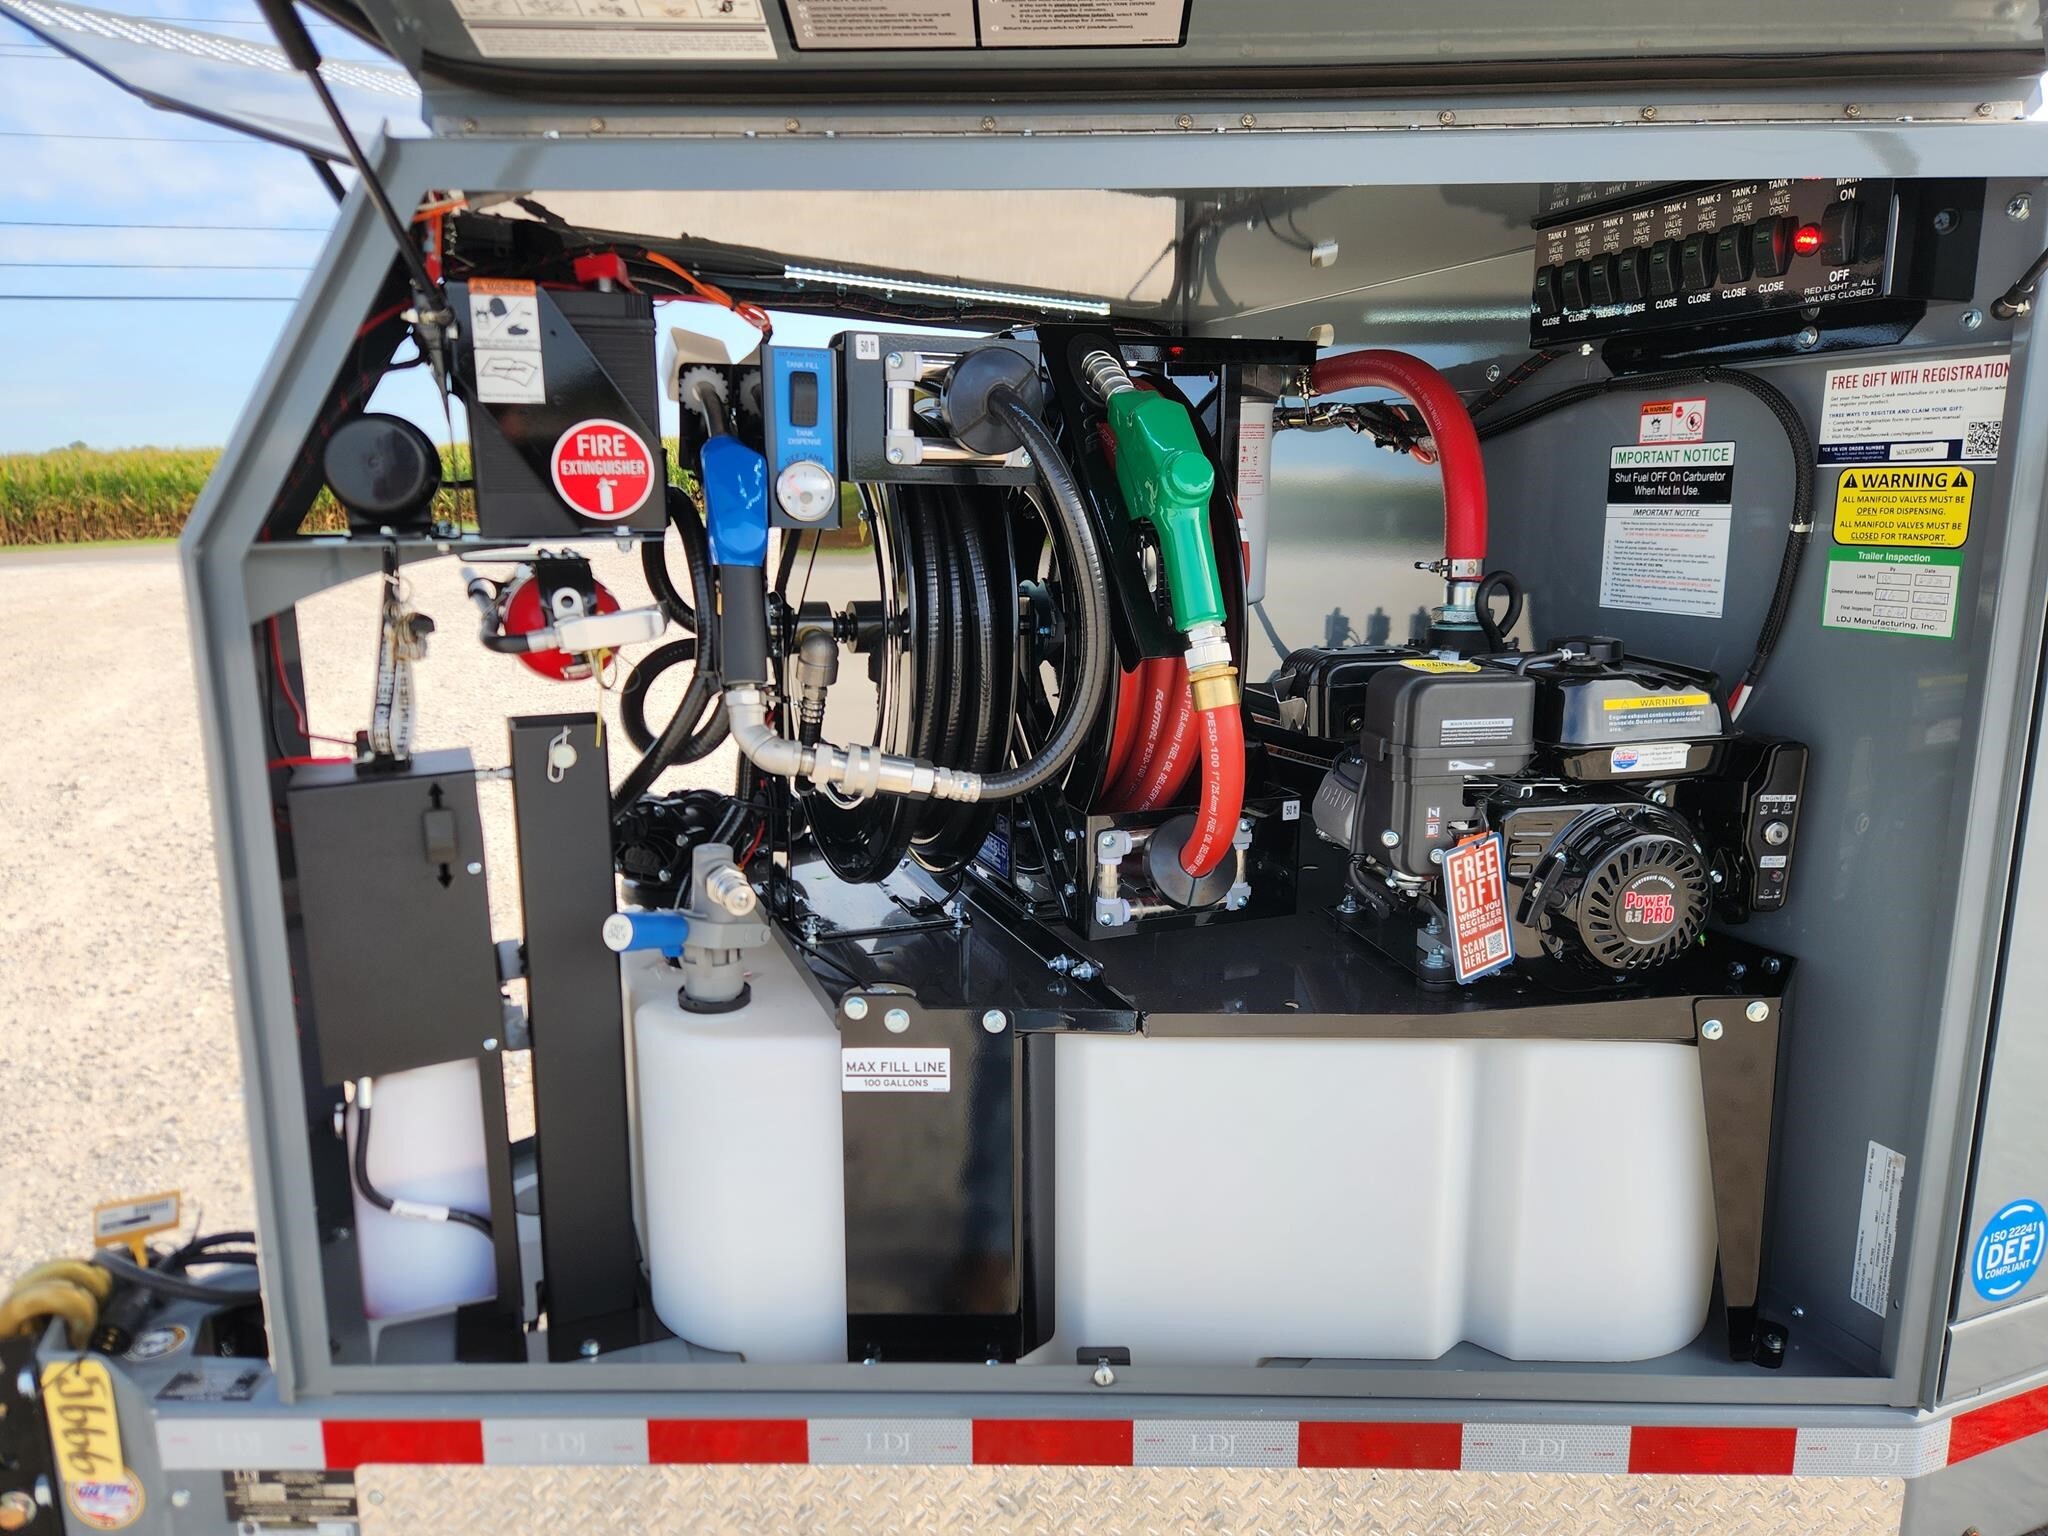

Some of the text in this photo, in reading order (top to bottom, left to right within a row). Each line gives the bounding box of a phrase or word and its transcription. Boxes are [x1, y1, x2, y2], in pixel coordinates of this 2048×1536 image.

[1768, 179, 1789, 190] TANK
[1731, 185, 1758, 198] TANK 2
[1839, 187, 1856, 201] ON
[1696, 193, 1721, 206] TANK 3
[1769, 194, 1791, 206] VALVE
[1663, 201, 1687, 214] TANK 4
[1732, 202, 1753, 214] VALVE
[1768, 204, 1789, 216] OPEN
[1632, 209, 1655, 221] TANK 5
[1697, 210, 1717, 222] VALVE
[1732, 212, 1751, 223] OPEN
[1602, 217, 1624, 228] TANK 6
[1664, 218, 1682, 229] VALVE
[1697, 220, 1716, 231] OPEN
[1574, 223, 1594, 235] TANK 7
[1633, 225, 1651, 236] VALVE
[1664, 228, 1682, 238] OPEN
[1548, 230, 1567, 241] TANK 8
[1603, 232, 1620, 242] VALVE
[1633, 234, 1650, 245] OPEN
[1548, 245, 1564, 254] VALVE
[1575, 239, 1591, 248] VALVE
[1603, 241, 1619, 251] OPEN
[1548, 253, 1563, 263] OPEN
[1575, 247, 1590, 257] OPEN
[1829, 269, 1850, 283] OFF
[1758, 281, 1784, 293] CLOSE
[1803, 286, 1822, 295] RED
[1823, 282, 1849, 293] LIGHT
[1860, 278, 1877, 287] ALL
[1687, 292, 1711, 304] CLOSE
[1722, 287, 1747, 299] CLOSE
[1804, 287, 1874, 304] VALVES CLOSED
[1655, 298, 1678, 309] CLOSE
[1541, 316, 1561, 327] CLOSE
[1568, 312, 1587, 323] CLOSE
[861, 341, 869, 353] 50
[786, 360, 819, 370] TANK FILL
[1831, 374, 1859, 390] FREE
[1862, 371, 1887, 388] GIFT
[1890, 369, 1918, 385] WITH
[576, 434, 627, 457] FIRE
[787, 438, 822, 446] DISPENSE
[1615, 447, 1729, 464] IMPORTANT NOTICE
[560, 459, 646, 476] EXTINGUISHER
[1615, 471, 1726, 483] Shut Fuel OFF On Carburetor
[1862, 472, 1948, 489] WARNING
[1634, 485, 1700, 495] When Not In Use.
[1929, 496, 1953, 504] MUST
[1955, 496, 1965, 504] BE
[1632, 509, 1676, 517] IMPORTANT
[1856, 507, 1946, 516] OPEN FOR DISPENSING.
[1854, 521, 1895, 529] MANIFOLD
[1897, 521, 1925, 530] VALVES
[1926, 522, 1950, 530] MUST
[1851, 532, 1879, 540] CLOSED
[1898, 533, 1947, 542] TRANSPORT.
[1858, 552, 1931, 563] Trailer Inspection
[1836, 615, 1938, 631] LDJ Manufacturing, Inc.
[1639, 697, 1686, 707] WARNING
[1206, 711, 1220, 768] PE30-100
[1167, 741, 1180, 760] FUEL
[1164, 758, 1173, 773] OIL
[1150, 771, 1168, 801] DELIVERY
[1321, 785, 1353, 811] OHV
[1285, 802, 1293, 816] 50
[1207, 815, 1217, 835] FUEL
[1204, 833, 1213, 846] OIL
[1453, 846, 1497, 887] FREE
[1456, 873, 1499, 913] GIFT
[1624, 891, 1672, 910] Power
[1458, 899, 1501, 923] WHEN YOU
[1625, 905, 1675, 924] 6.5 PRO
[1460, 908, 1502, 931] REGISTER
[1460, 916, 1503, 939] YOUR TRAILER
[1462, 936, 1485, 957] SCAN
[1464, 949, 1487, 970] HERE
[846, 1062, 946, 1073] MAX FILL LINE
[864, 1079, 929, 1087] 100 GALLONS
[1990, 1223, 2037, 1244] ISO 22241
[1985, 1234, 2036, 1270] DEF
[1984, 1259, 2032, 1280] COMPLIANT
[865, 1432, 911, 1456] LDJ
[1190, 1434, 1240, 1458] LDJ
[1519, 1438, 1568, 1464] LDJ
[1854, 1443, 1905, 1467] LDJ
